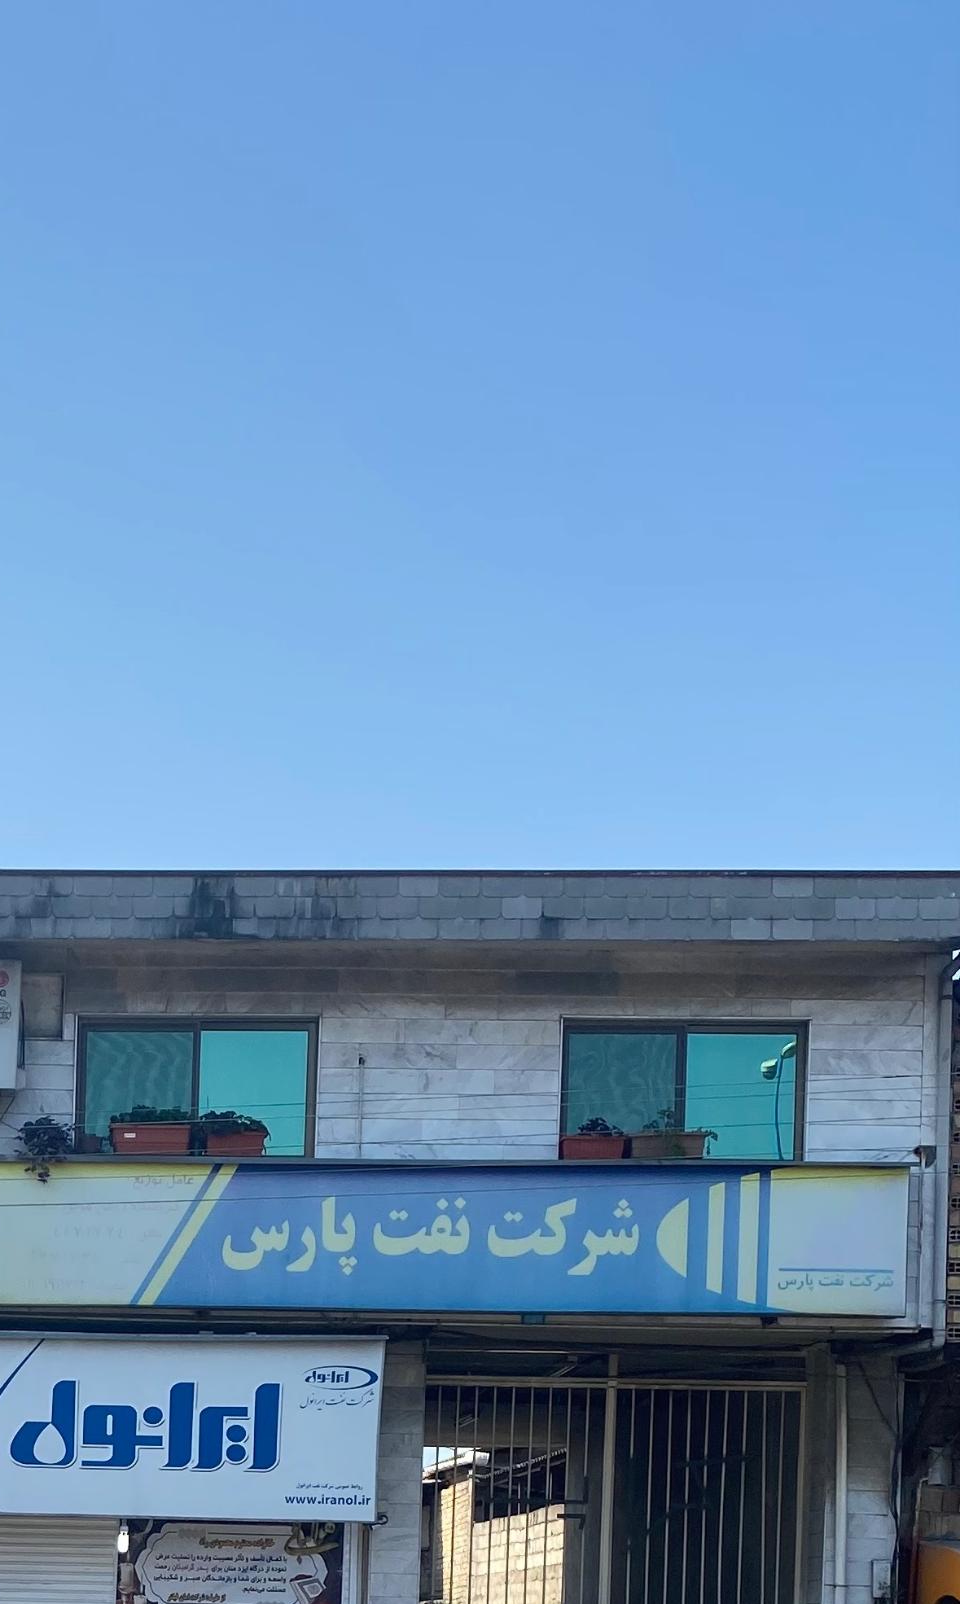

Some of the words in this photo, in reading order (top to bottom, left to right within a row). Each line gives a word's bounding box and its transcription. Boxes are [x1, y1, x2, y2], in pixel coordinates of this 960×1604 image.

[221, 1196, 359, 1276] پارس
[372, 1196, 471, 1257] نفت
[487, 1197, 640, 1276] شرکت
[777, 1272, 814, 1292] پارس
[818, 1273, 844, 1288] نفت
[849, 1273, 895, 1292] شرکت
[304, 1370, 350, 1384] ایرانول
[325, 1391, 346, 1406] نفت
[346, 1388, 375, 1408] شرکت
[9, 1380, 282, 1472] ایرانول
[284, 1494, 372, 1506] www.iranol.ir
